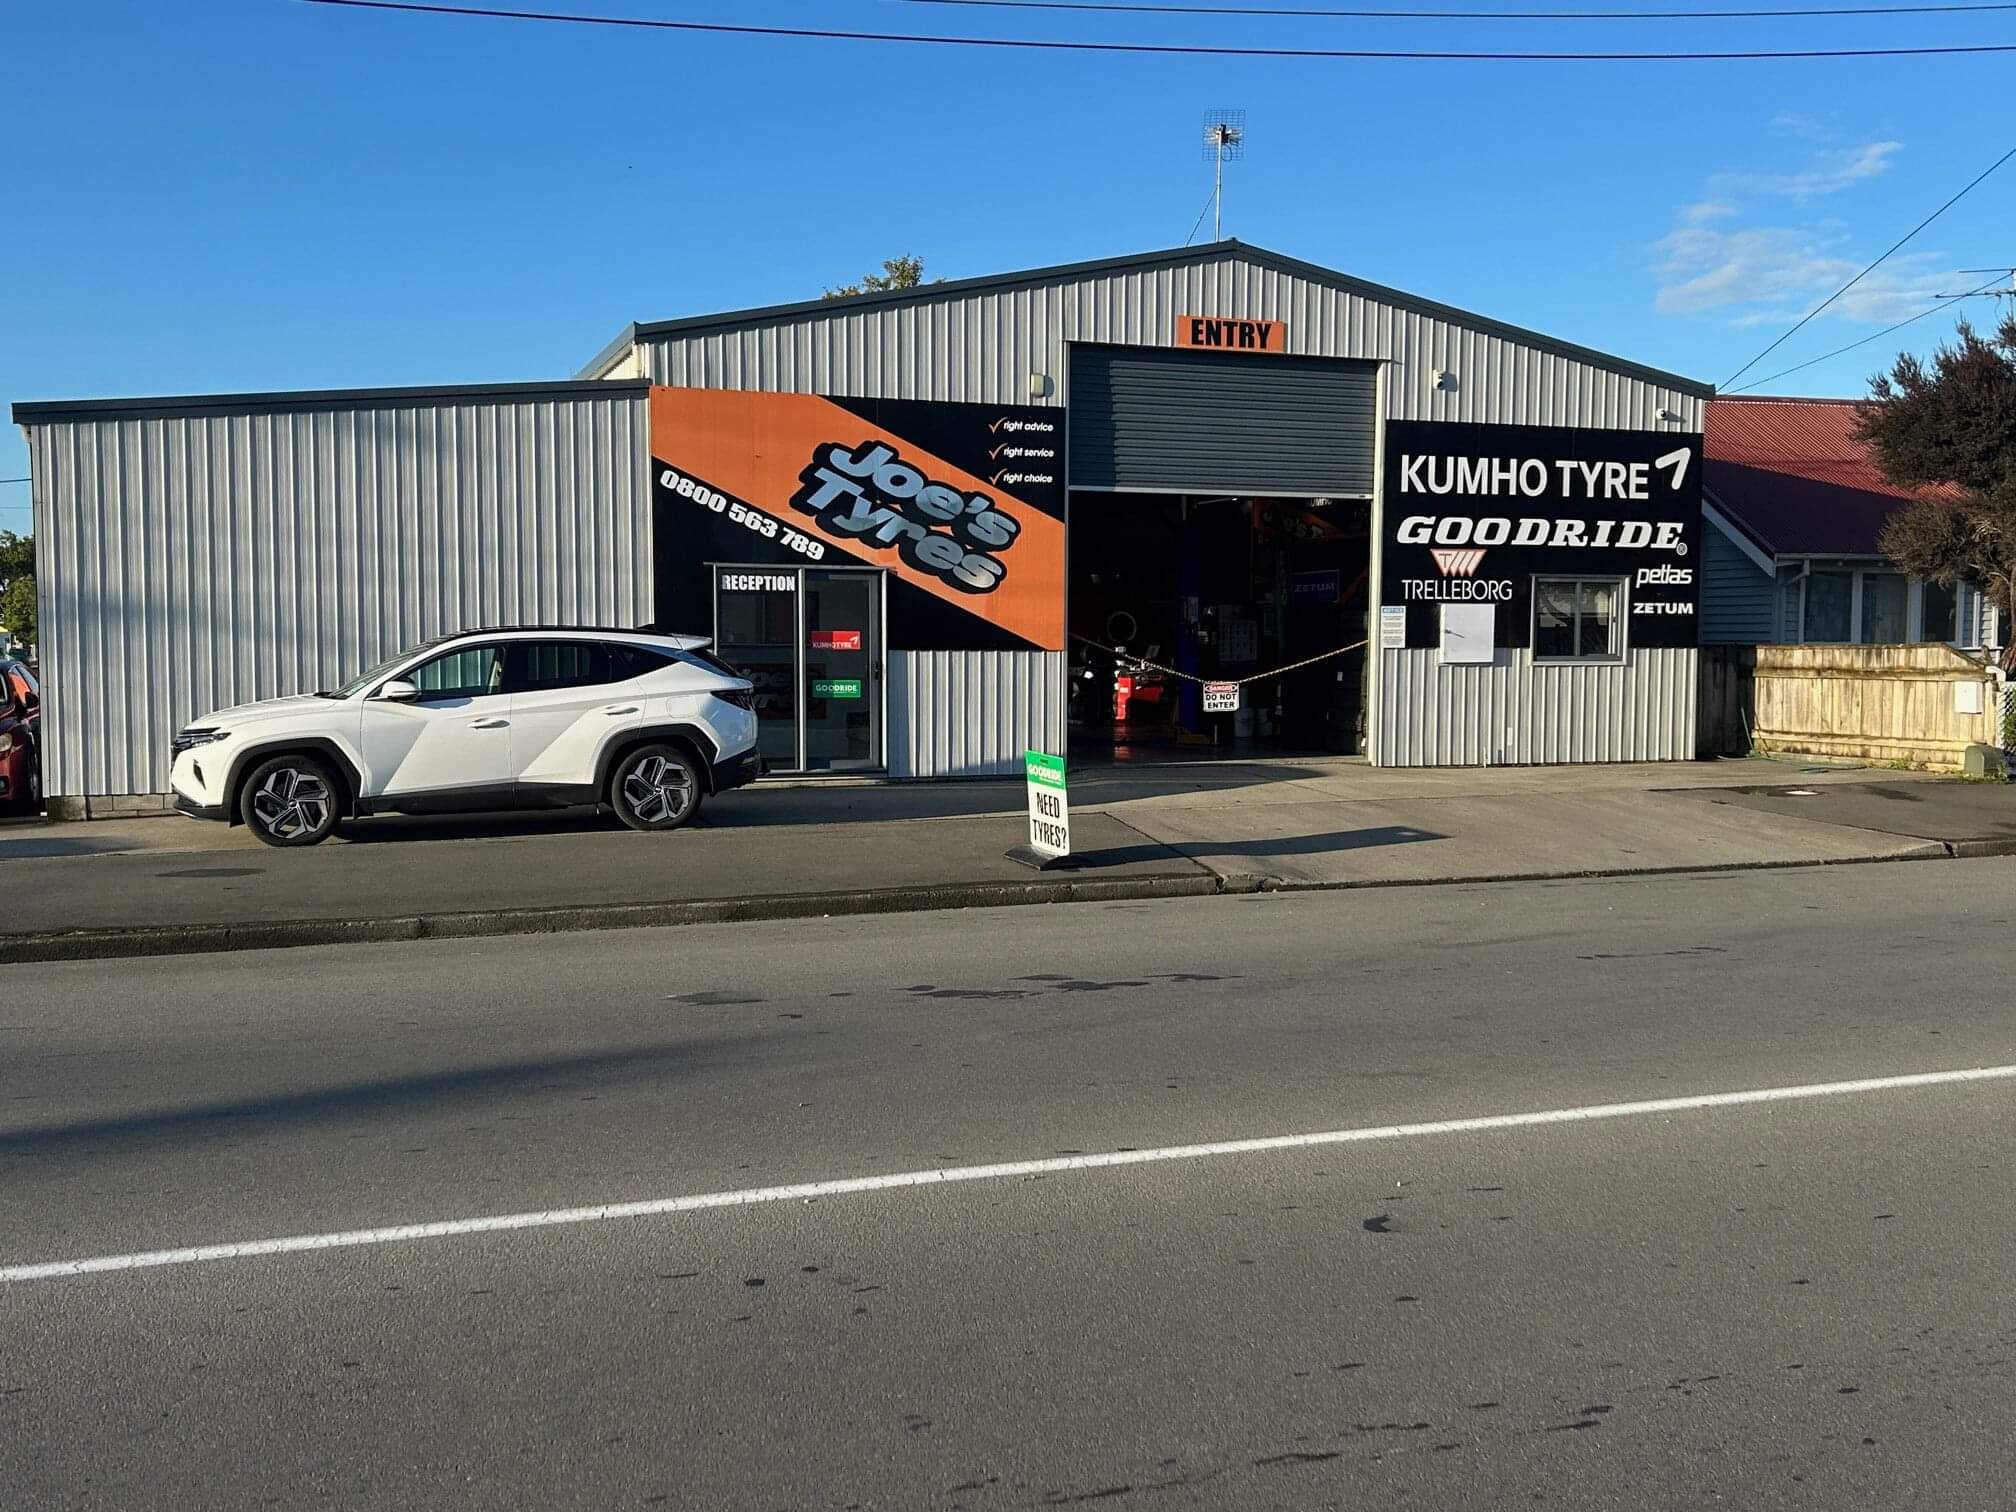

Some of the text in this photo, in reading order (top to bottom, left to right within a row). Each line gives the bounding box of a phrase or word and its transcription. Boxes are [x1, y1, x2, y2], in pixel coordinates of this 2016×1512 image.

[1191, 319, 1272, 349] ENTRY
[1003, 421, 1054, 432] right advice
[1003, 447, 1055, 458] right service
[1003, 473, 1053, 484] right choice
[1400, 454, 1650, 499] KUMHO TYRE
[829, 445, 1018, 547] Joe's
[659, 469, 825, 561] 0800 563 789
[806, 468, 1004, 590] Tyres
[1396, 516, 1684, 549] GOODRIDE
[722, 575, 796, 592] RECEPTION
[1635, 563, 1693, 588] petlas
[1401, 579, 1513, 600] TRELLEBORG
[1633, 602, 1694, 615] ZETUM
[815, 684, 857, 692] GOODRIDE
[1207, 701, 1235, 709] ENTER
[1036, 792, 1060, 818] NEED
[1032, 819, 1067, 850] TYRES?
